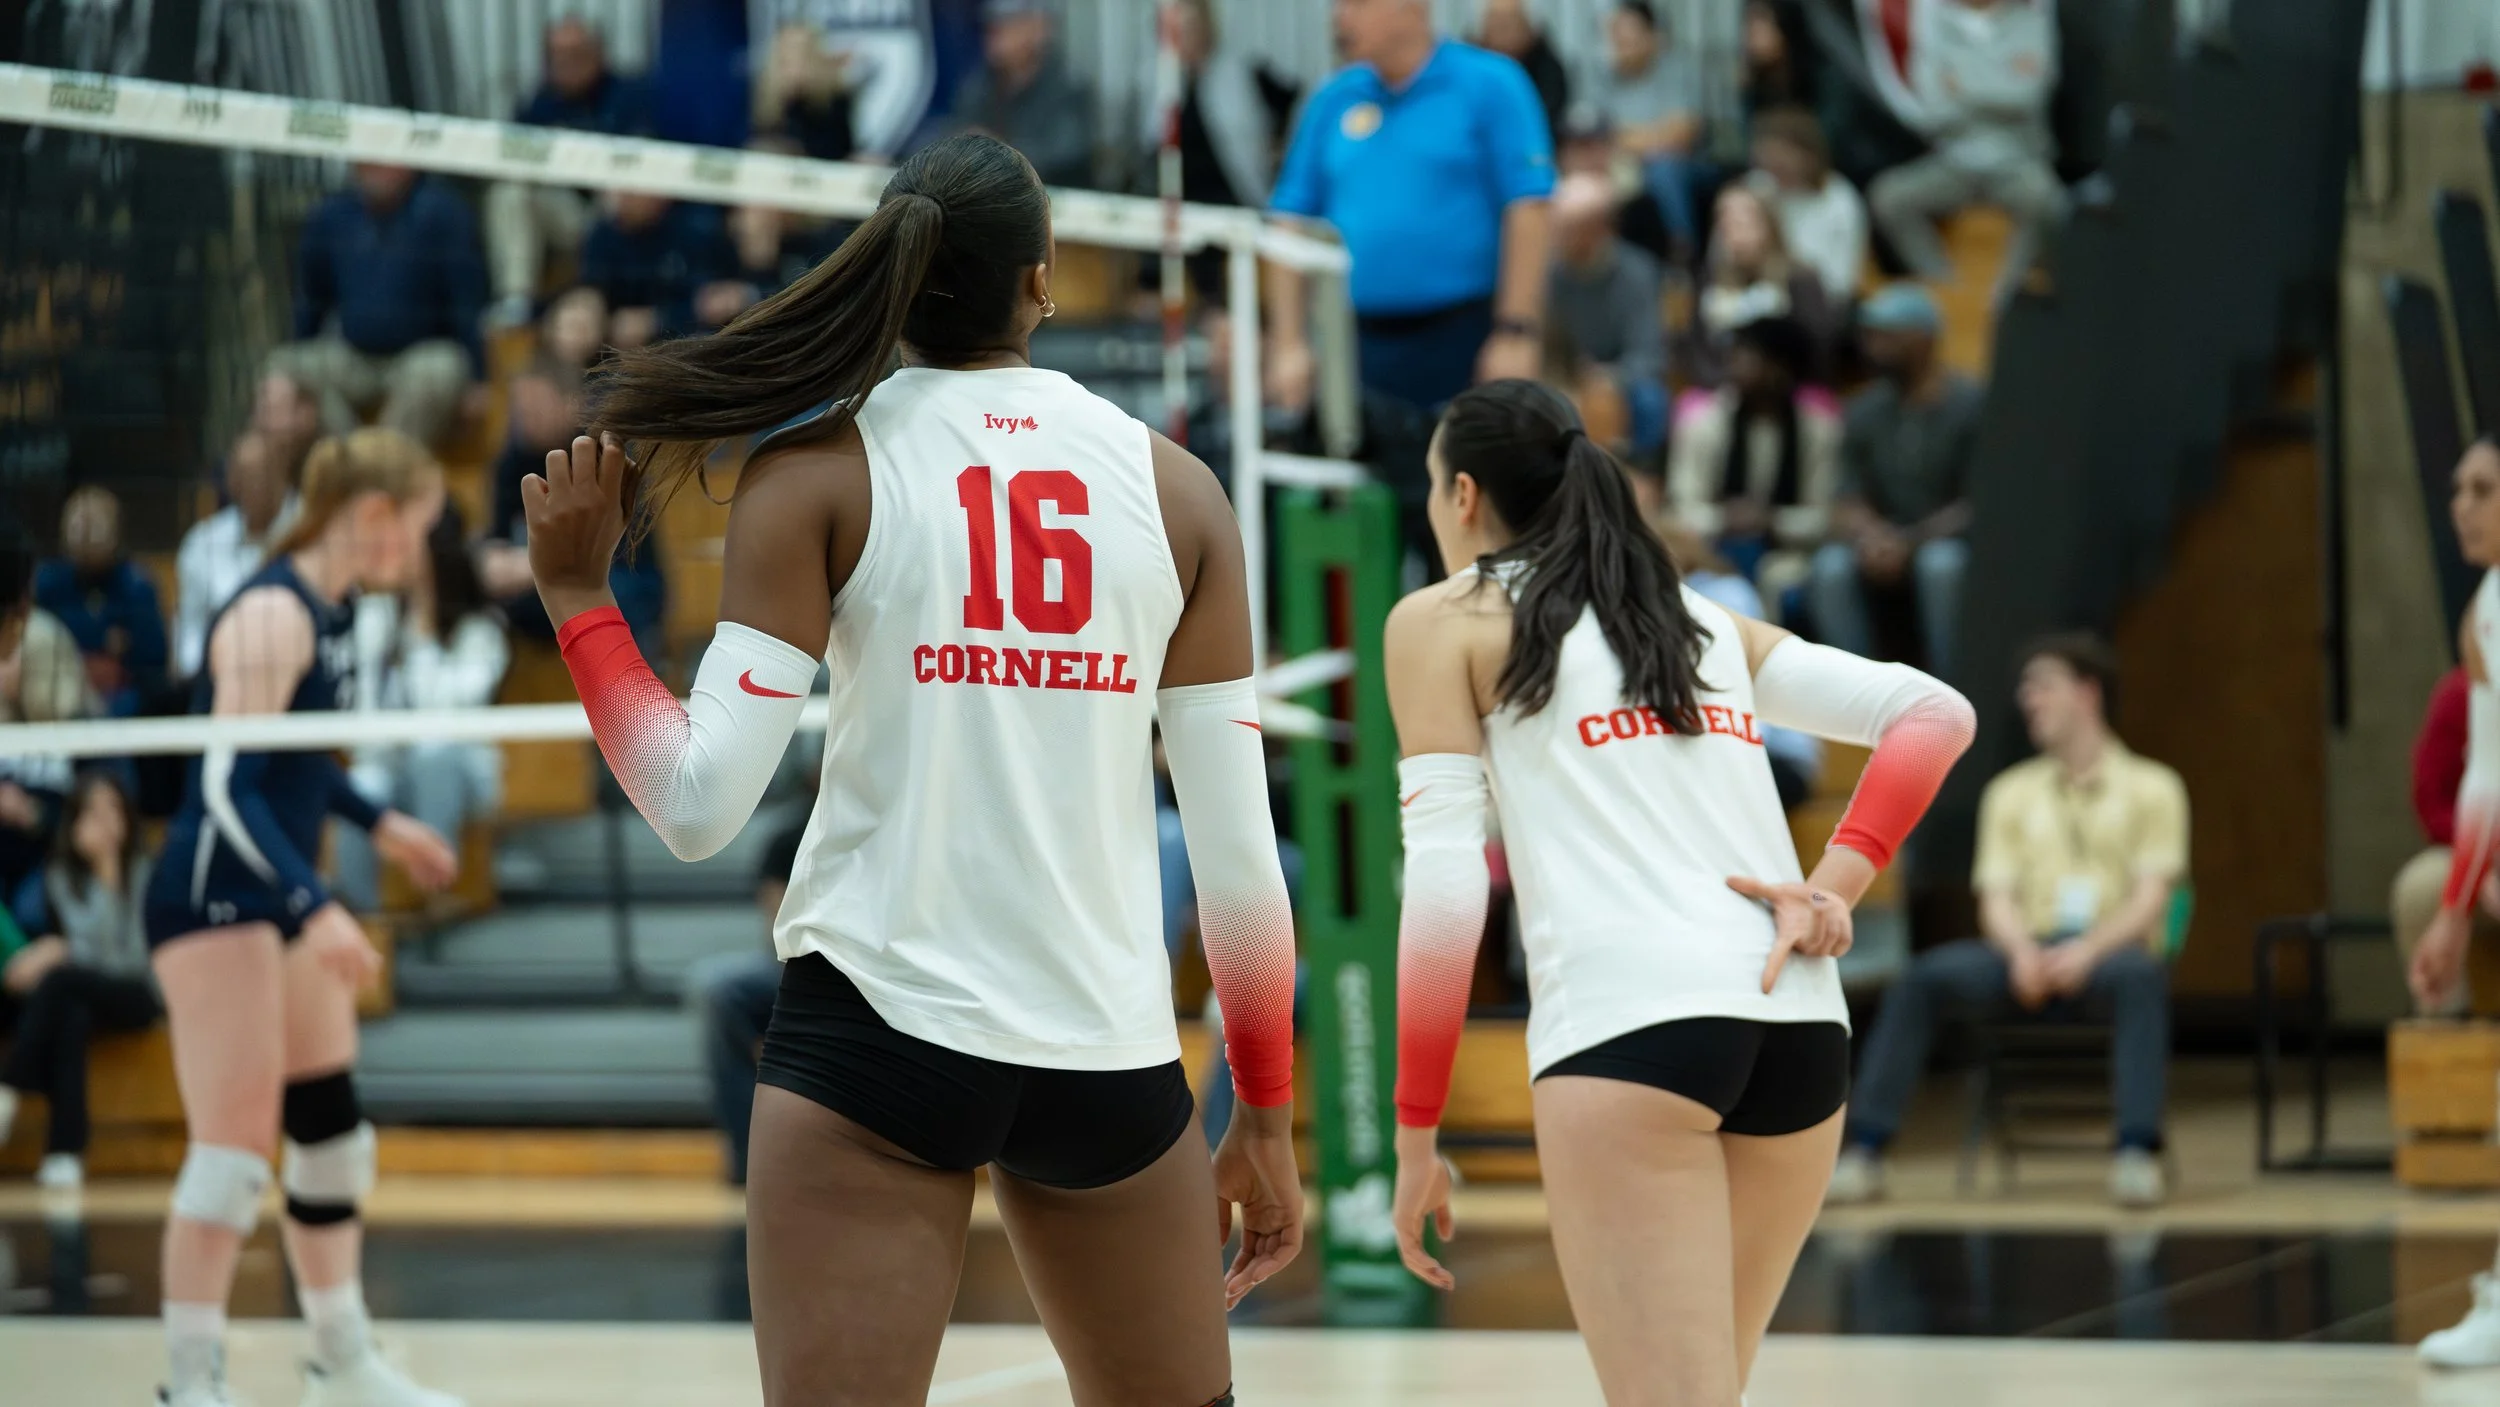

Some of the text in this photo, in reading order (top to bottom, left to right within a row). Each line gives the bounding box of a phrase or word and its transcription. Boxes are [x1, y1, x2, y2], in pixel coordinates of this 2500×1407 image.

[984, 413, 1019, 434] Ivy
[957, 465, 1092, 634] 16
[913, 644, 1137, 694] CORNELL
[1577, 704, 1764, 747] CORELL
